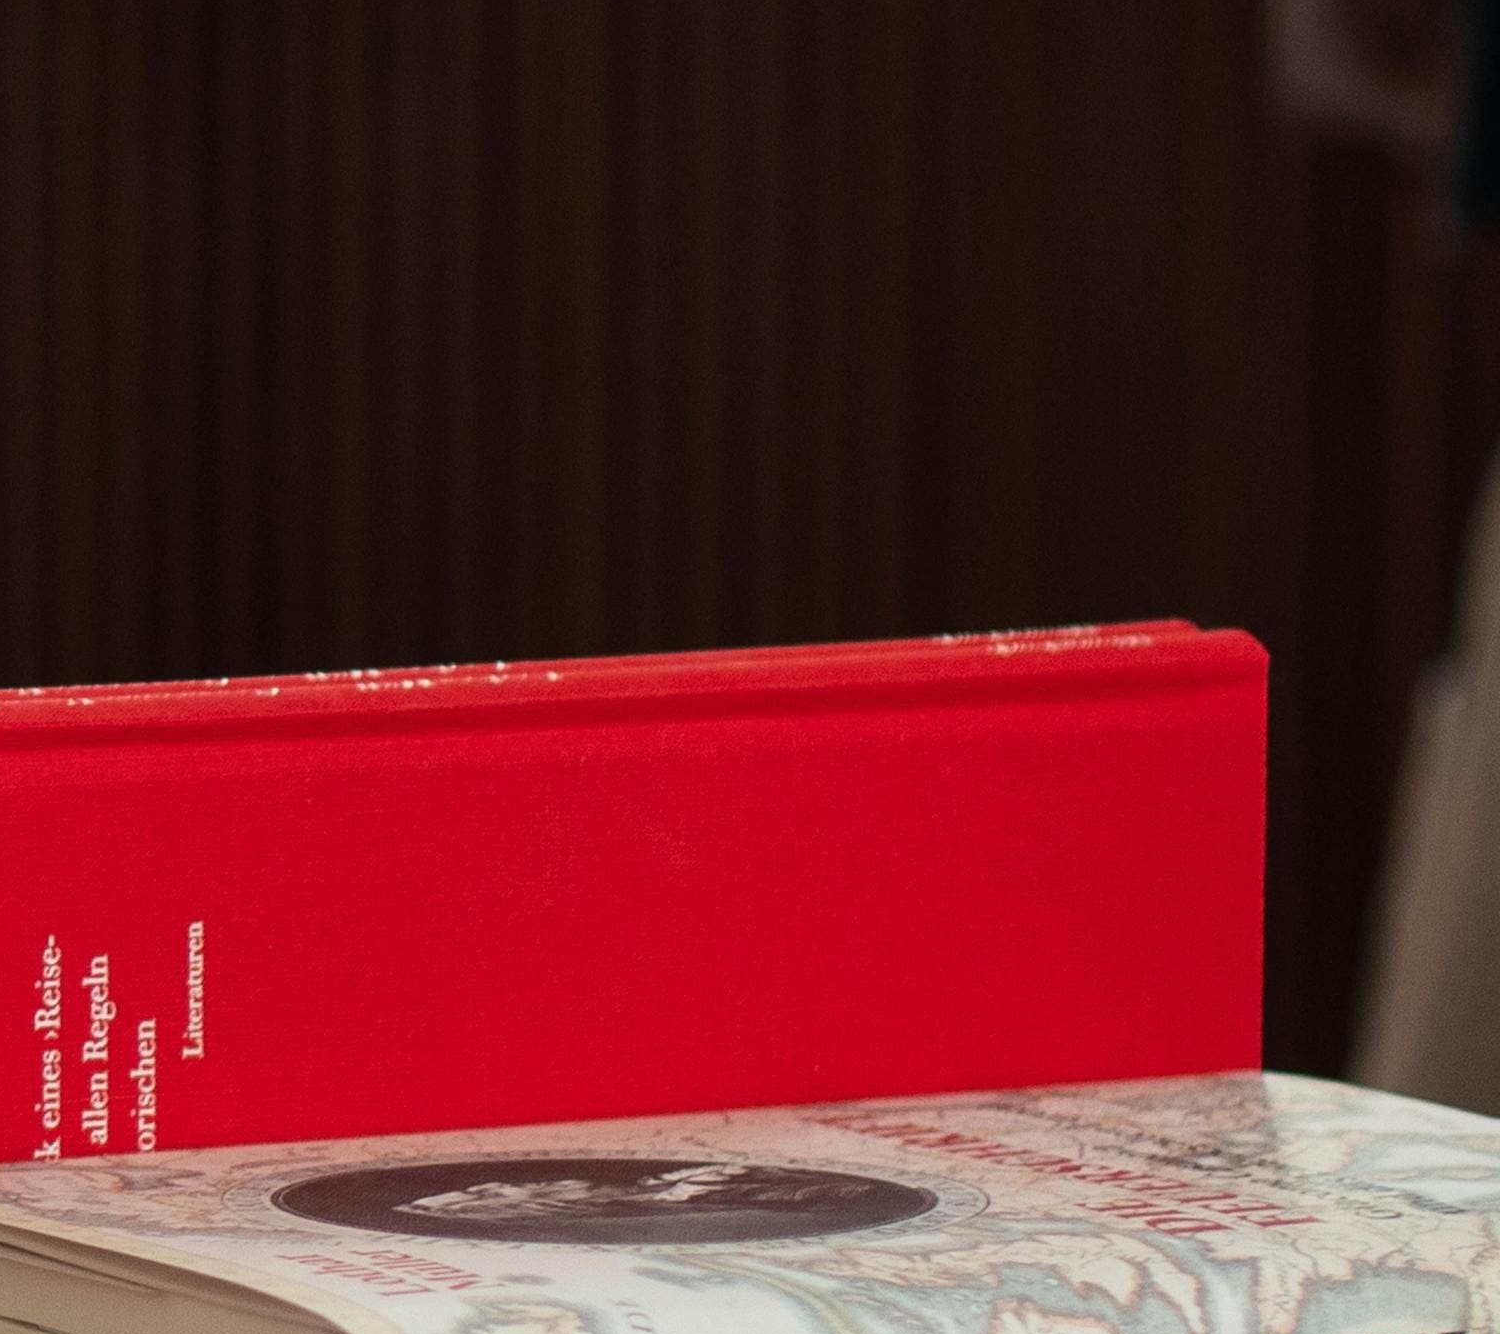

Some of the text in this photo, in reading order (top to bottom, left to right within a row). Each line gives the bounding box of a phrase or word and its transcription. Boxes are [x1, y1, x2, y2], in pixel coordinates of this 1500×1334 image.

[182, 920, 204, 1060] Literaturen
[35, 1049, 61, 1128] eines
[82, 954, 116, 1145] allen Regeln
[130, 1018, 156, 1151] orischen
[1077, 1201, 1234, 1235] DIE
[276, 1253, 434, 1296] Lothar
[352, 1249, 483, 1290] Müller
